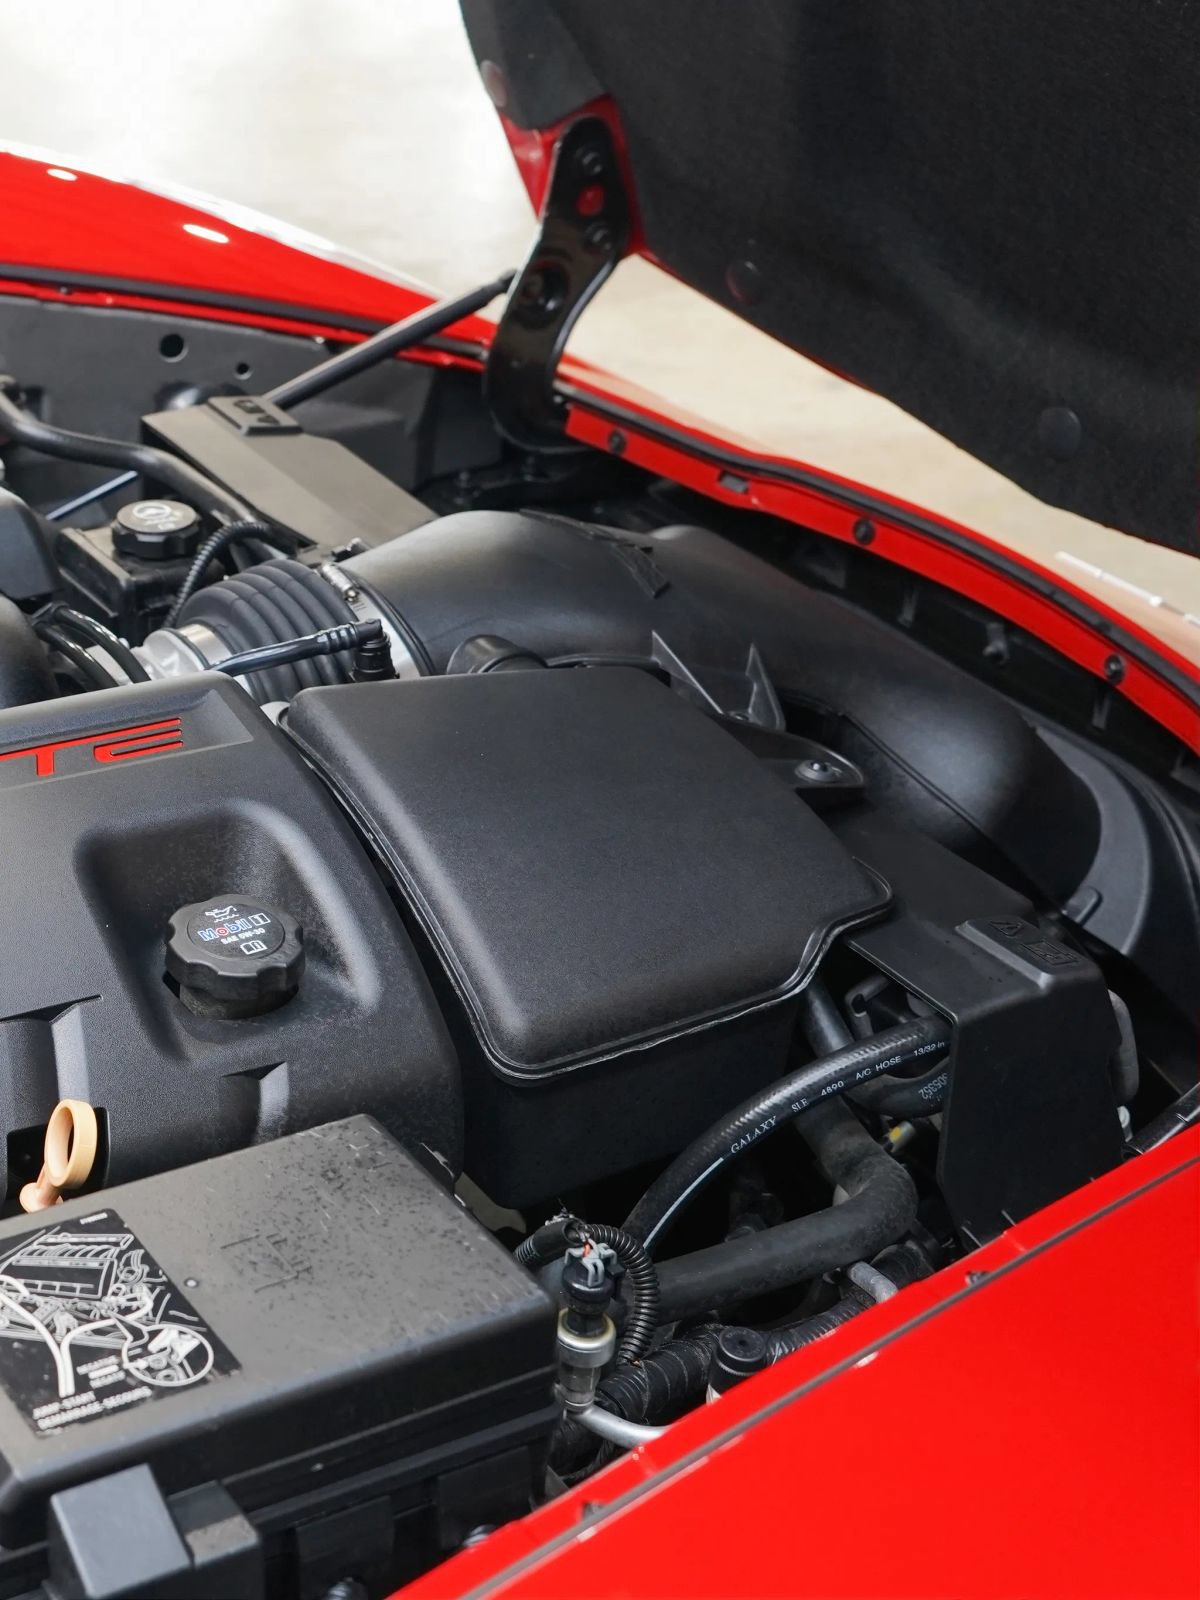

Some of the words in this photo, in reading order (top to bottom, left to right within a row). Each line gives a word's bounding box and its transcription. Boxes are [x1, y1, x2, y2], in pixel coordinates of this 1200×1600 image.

[197, 918, 252, 942] Mobil
[731, 1115, 777, 1154] GALAXY
[821, 1080, 845, 1097] 4890
[855, 1067, 872, 1081] A/C
[875, 1055, 902, 1072] HOSE
